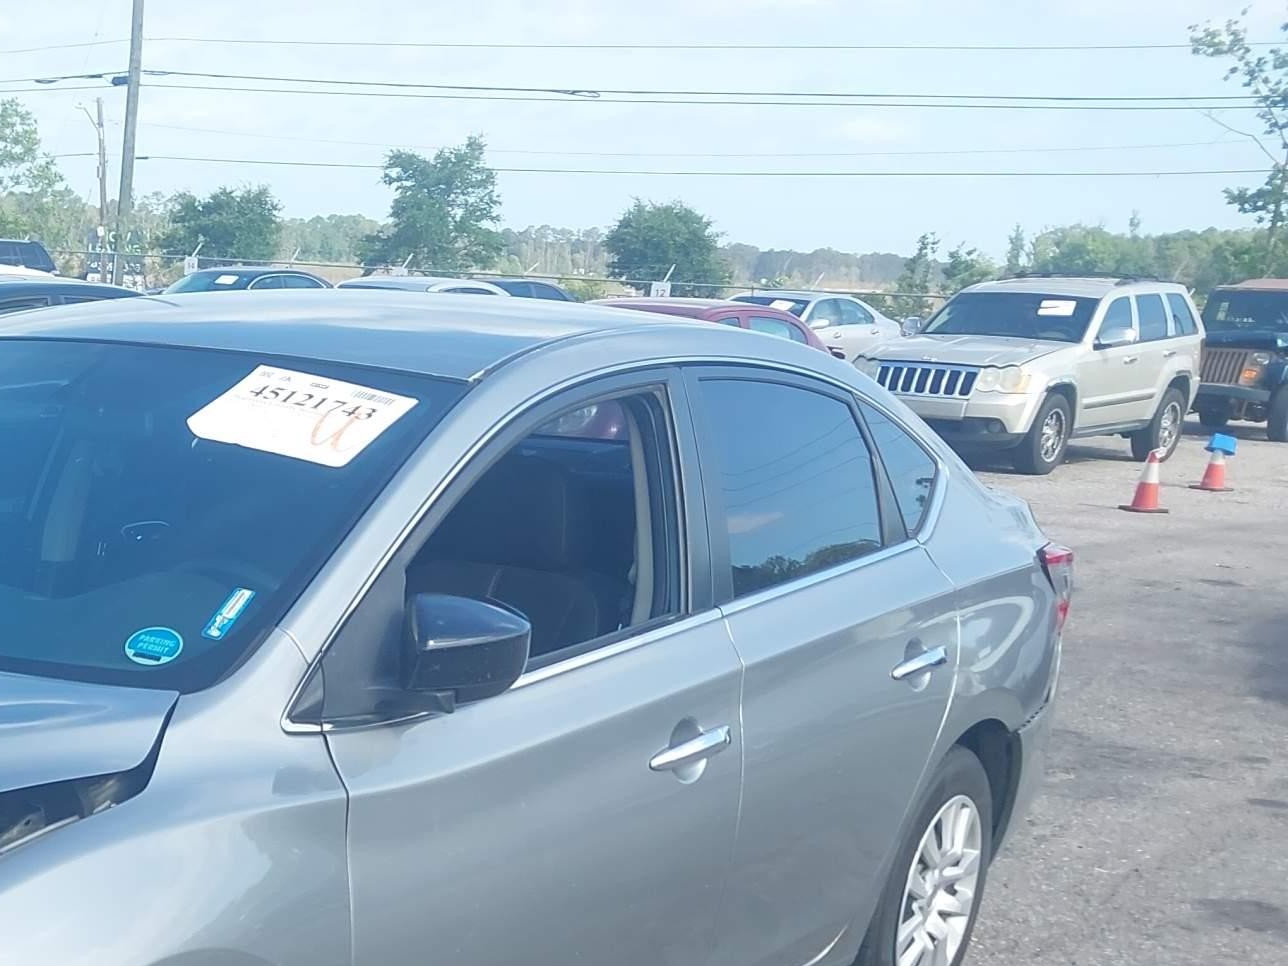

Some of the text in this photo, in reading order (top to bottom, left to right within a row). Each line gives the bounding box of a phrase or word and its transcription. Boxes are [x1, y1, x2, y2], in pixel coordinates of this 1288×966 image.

[249, 384, 378, 420] 45121743
[138, 634, 177, 647] PARKING
[137, 642, 170, 654] PERMIT
